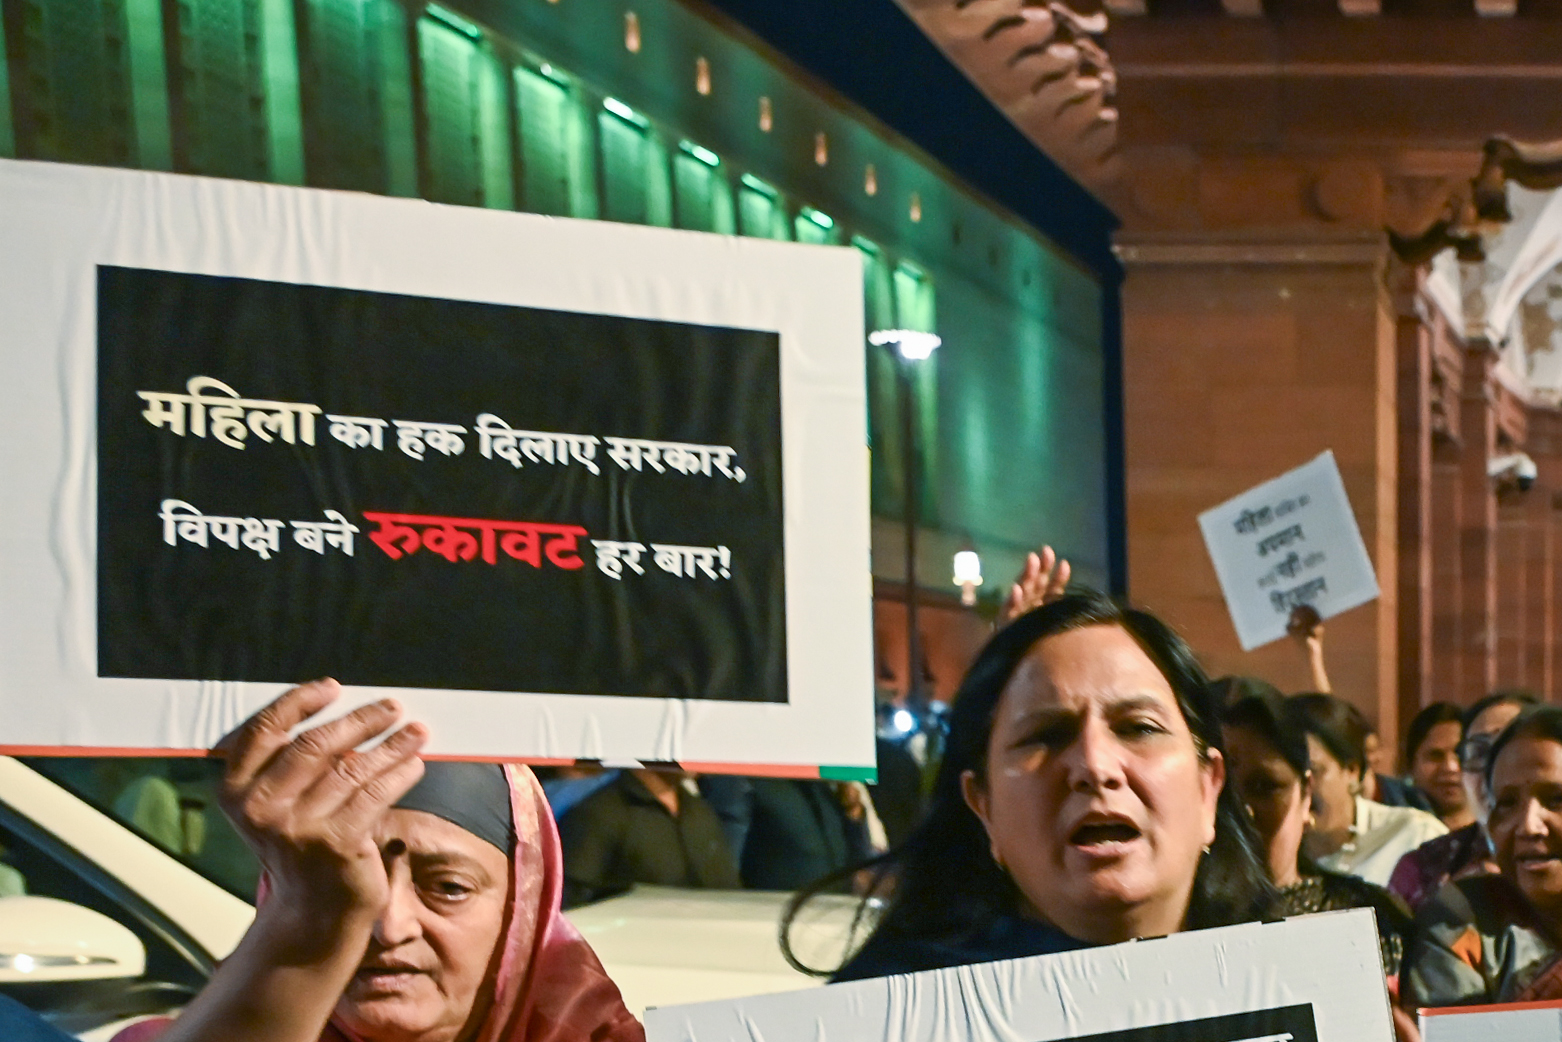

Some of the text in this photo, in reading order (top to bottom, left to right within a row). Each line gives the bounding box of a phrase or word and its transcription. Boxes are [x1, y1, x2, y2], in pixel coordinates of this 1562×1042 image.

[137, 376, 746, 482] महिला का हक दिलाए सरकार,
[160, 500, 730, 580] विपक्ष बने रुकावट हर बार!
